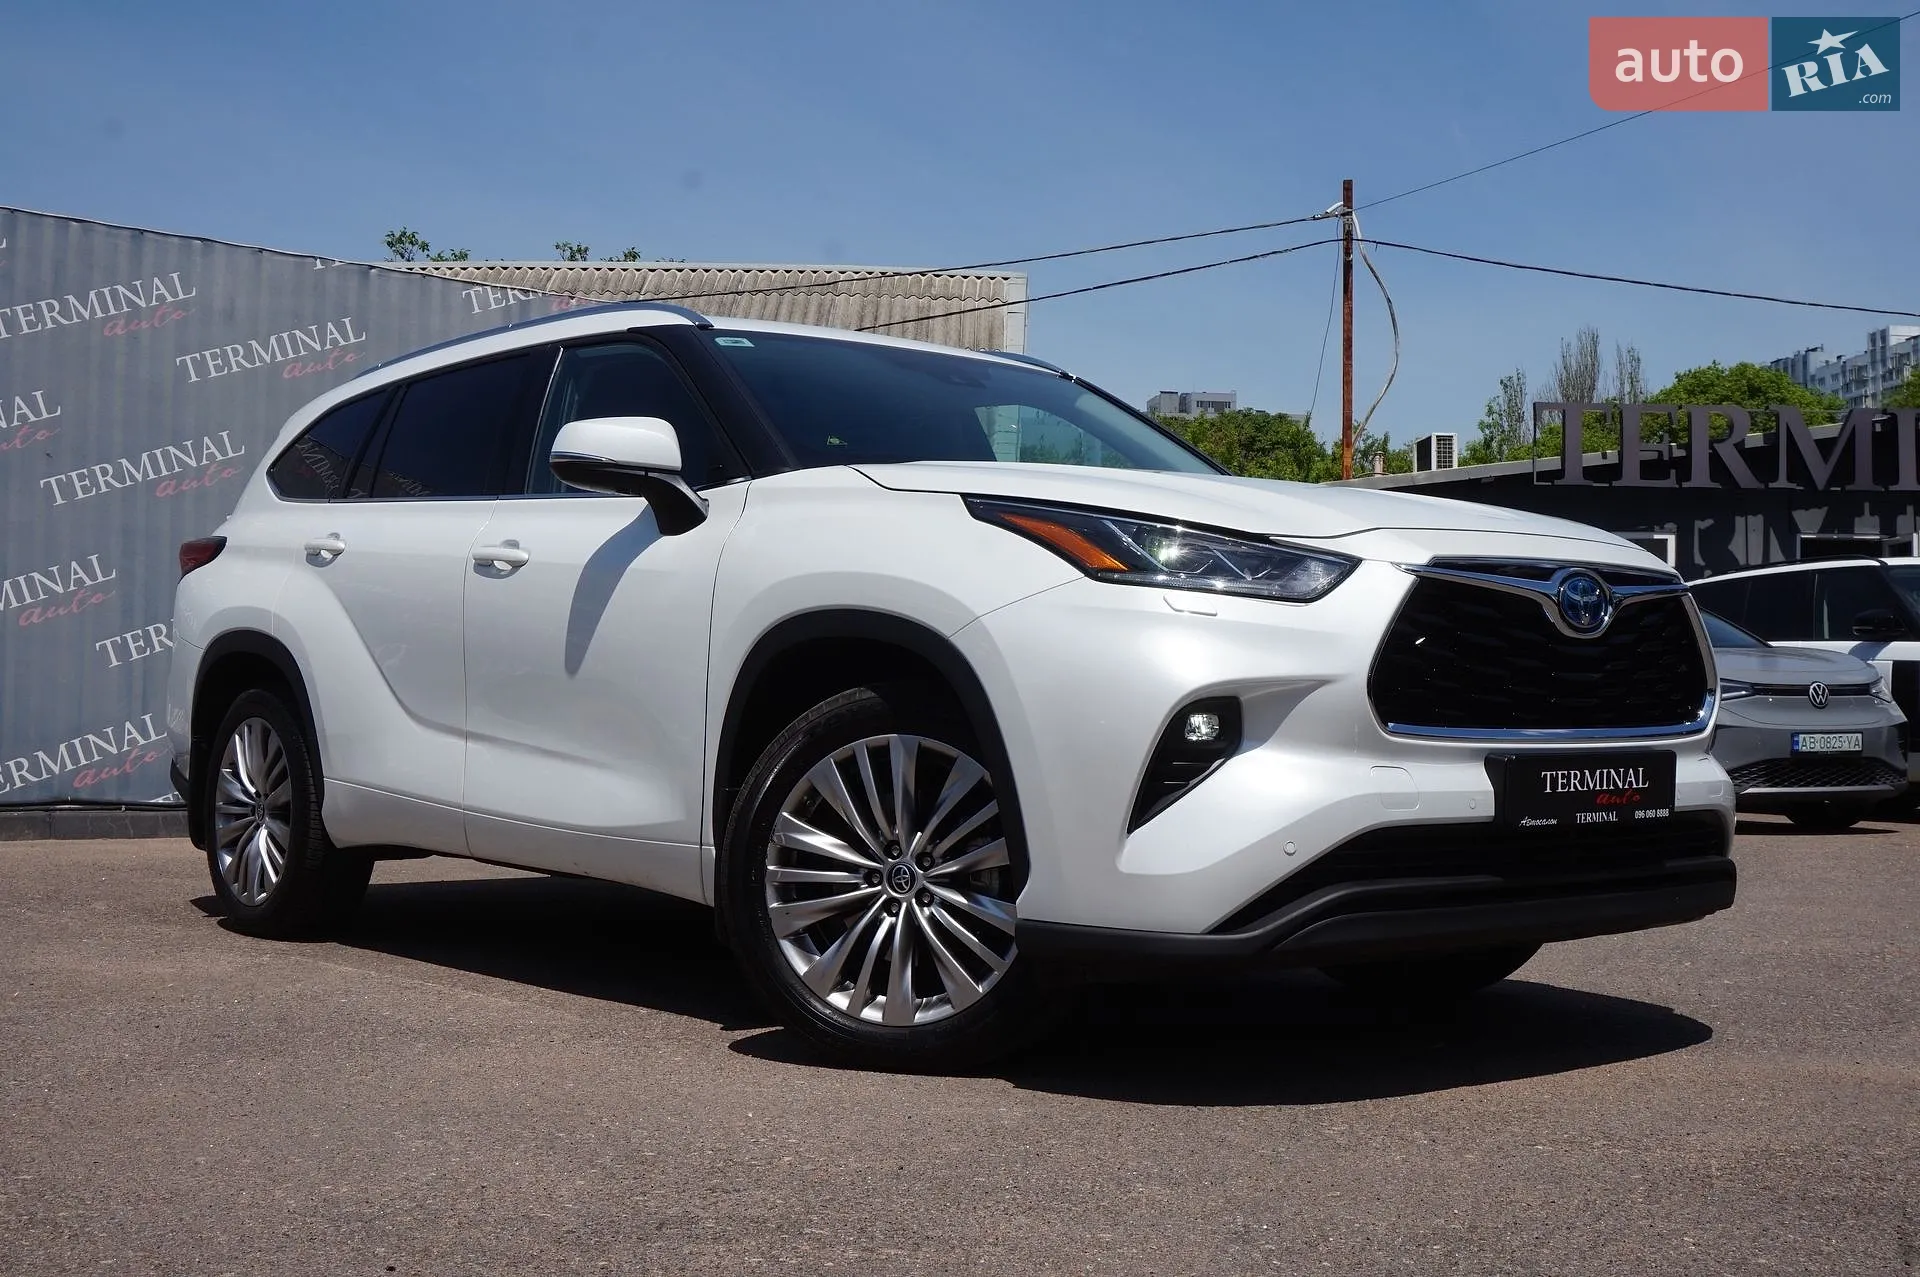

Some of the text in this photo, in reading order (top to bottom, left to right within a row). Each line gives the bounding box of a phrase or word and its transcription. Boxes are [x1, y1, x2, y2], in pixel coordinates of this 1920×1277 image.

[0, 271, 196, 339] TERMINAL
[103, 305, 196, 336] auto
[176, 317, 366, 383] TERMINAL
[282, 350, 366, 378] auto
[1534, 402, 1920, 491] TERMI
[40, 430, 245, 506] TERMINAL
[155, 463, 244, 497] auto
[18, 588, 116, 626] auto
[73, 748, 168, 789] auto
[1541, 767, 1649, 793] TERMINAL
[1596, 789, 1641, 805] auto
[1575, 810, 1619, 824] TERMINAL
